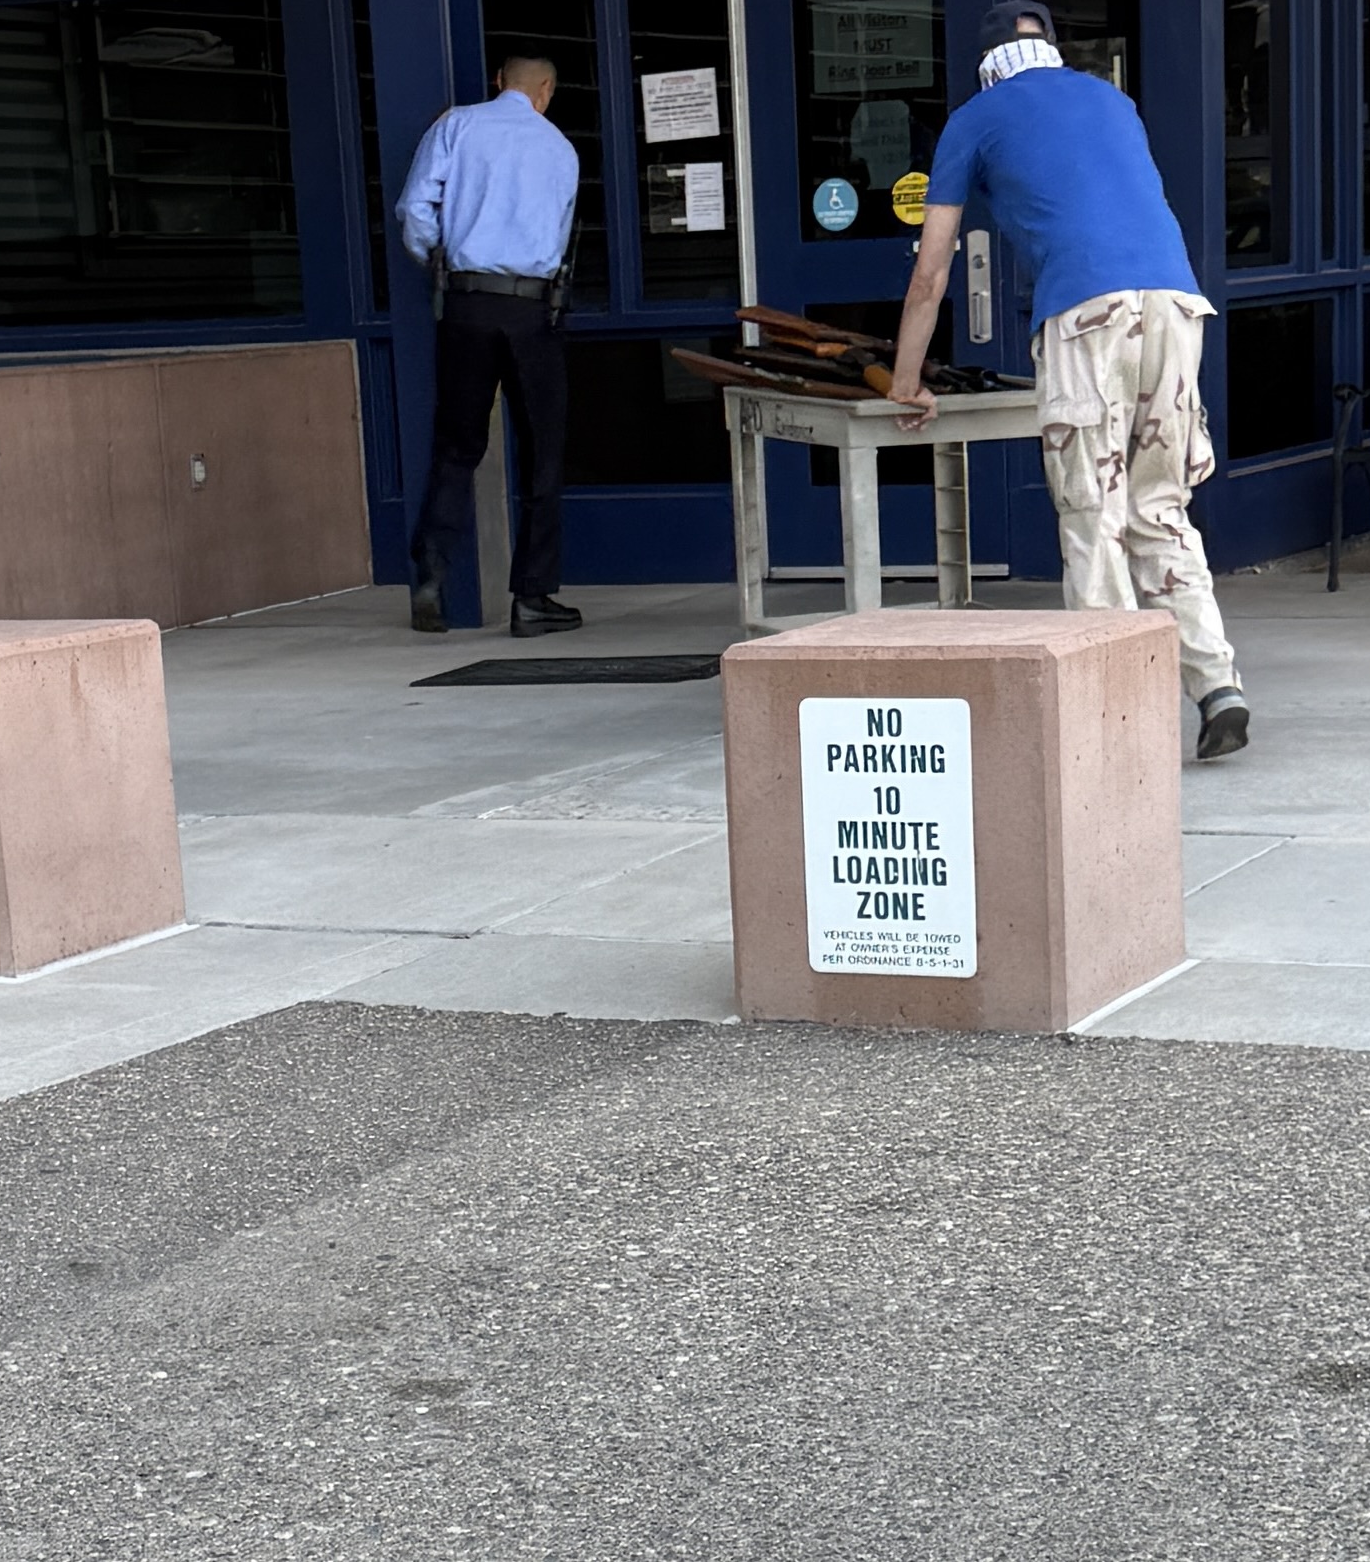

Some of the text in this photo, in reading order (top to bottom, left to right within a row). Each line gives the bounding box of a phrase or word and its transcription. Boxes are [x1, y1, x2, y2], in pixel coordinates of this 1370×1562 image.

[866, 707, 903, 738] NO
[826, 743, 947, 774] PARKING
[873, 786, 901, 816] 10
[837, 820, 941, 851] MINUTE
[832, 855, 948, 887] LOADING
[856, 891, 927, 921] ZONE
[823, 930, 962, 944] VEHICLES WILL BE TOWED
[834, 942, 846, 951] AT
[902, 944, 951, 956] EXPENSE
[822, 954, 844, 965] PER
[847, 955, 912, 967] ORDINANCE
